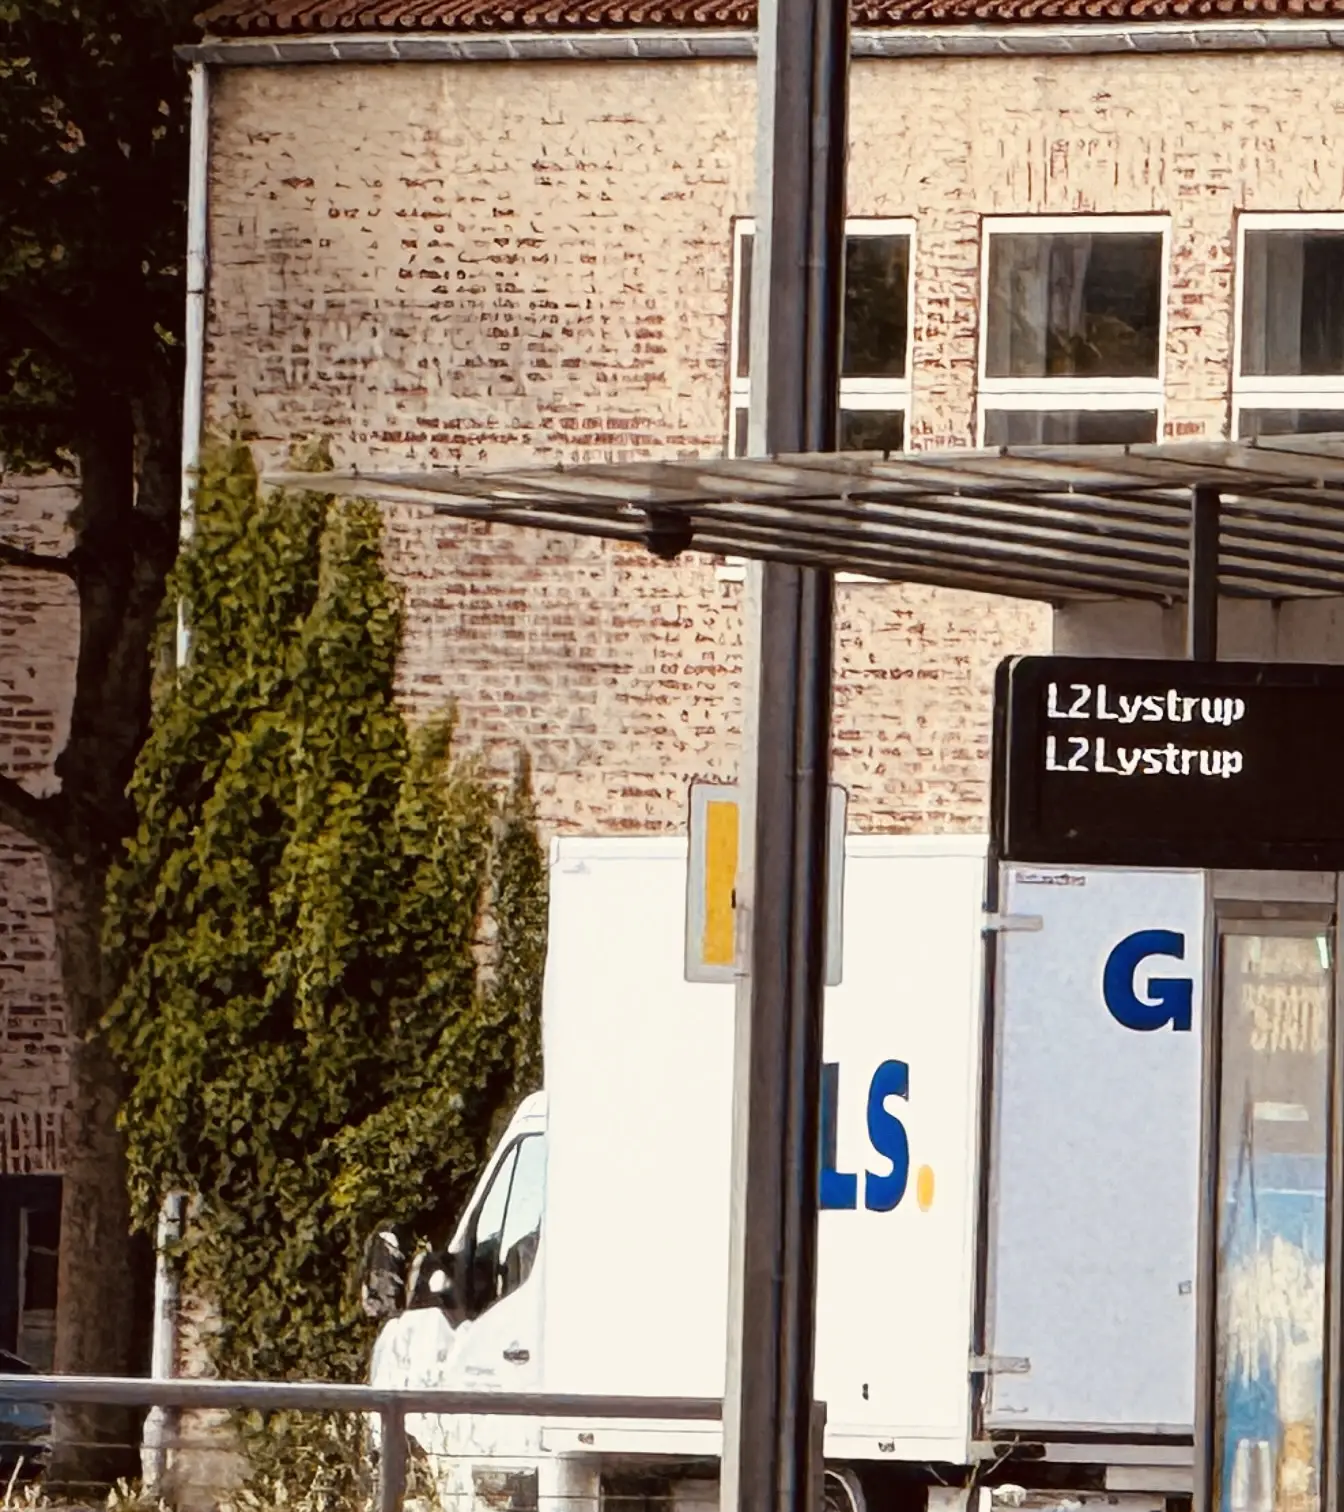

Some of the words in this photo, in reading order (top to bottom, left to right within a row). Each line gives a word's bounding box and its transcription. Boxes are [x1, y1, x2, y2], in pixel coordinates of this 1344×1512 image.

[1046, 681, 1092, 719] L2
[1095, 683, 1246, 727] Lystrup
[1045, 735, 1091, 773] L2
[1094, 736, 1244, 779] Lystrup
